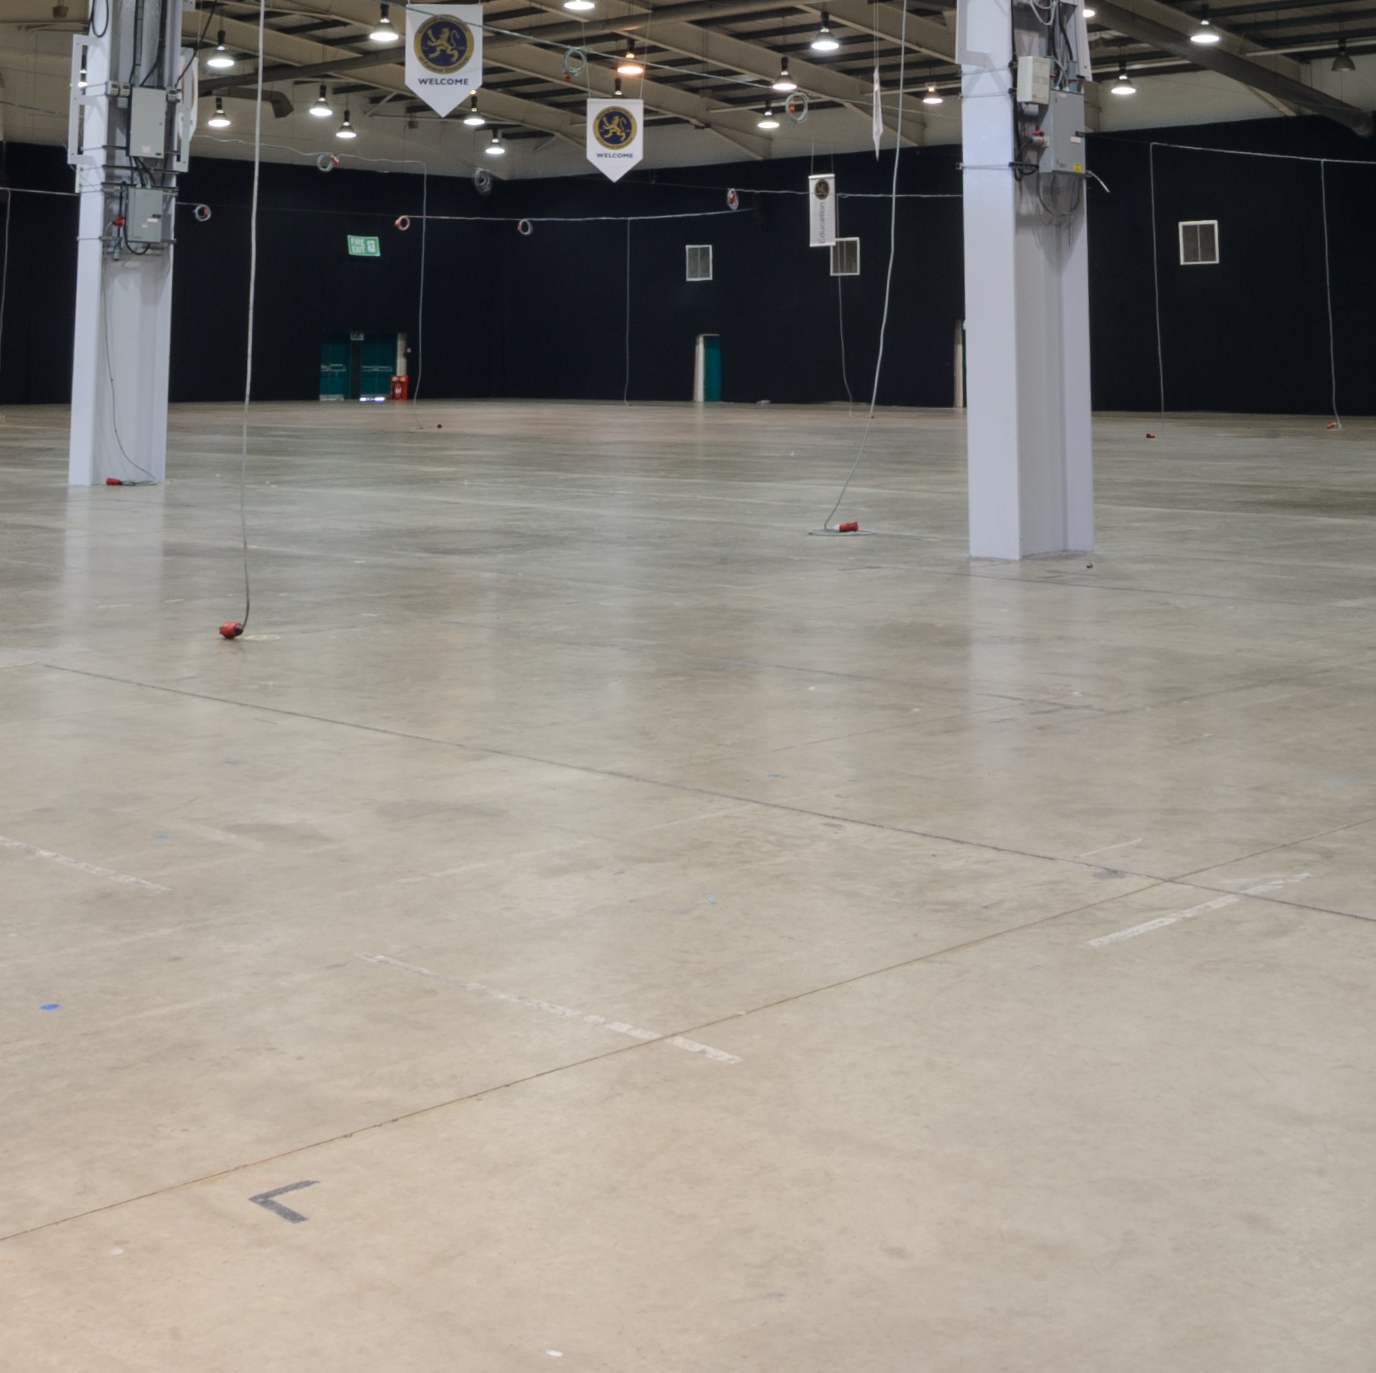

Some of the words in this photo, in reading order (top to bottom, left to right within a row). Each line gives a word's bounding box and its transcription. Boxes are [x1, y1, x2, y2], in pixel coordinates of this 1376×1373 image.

[418, 78, 469, 86] WELCOME
[350, 237, 365, 246] FIRE
[351, 245, 366, 254] EXIT
